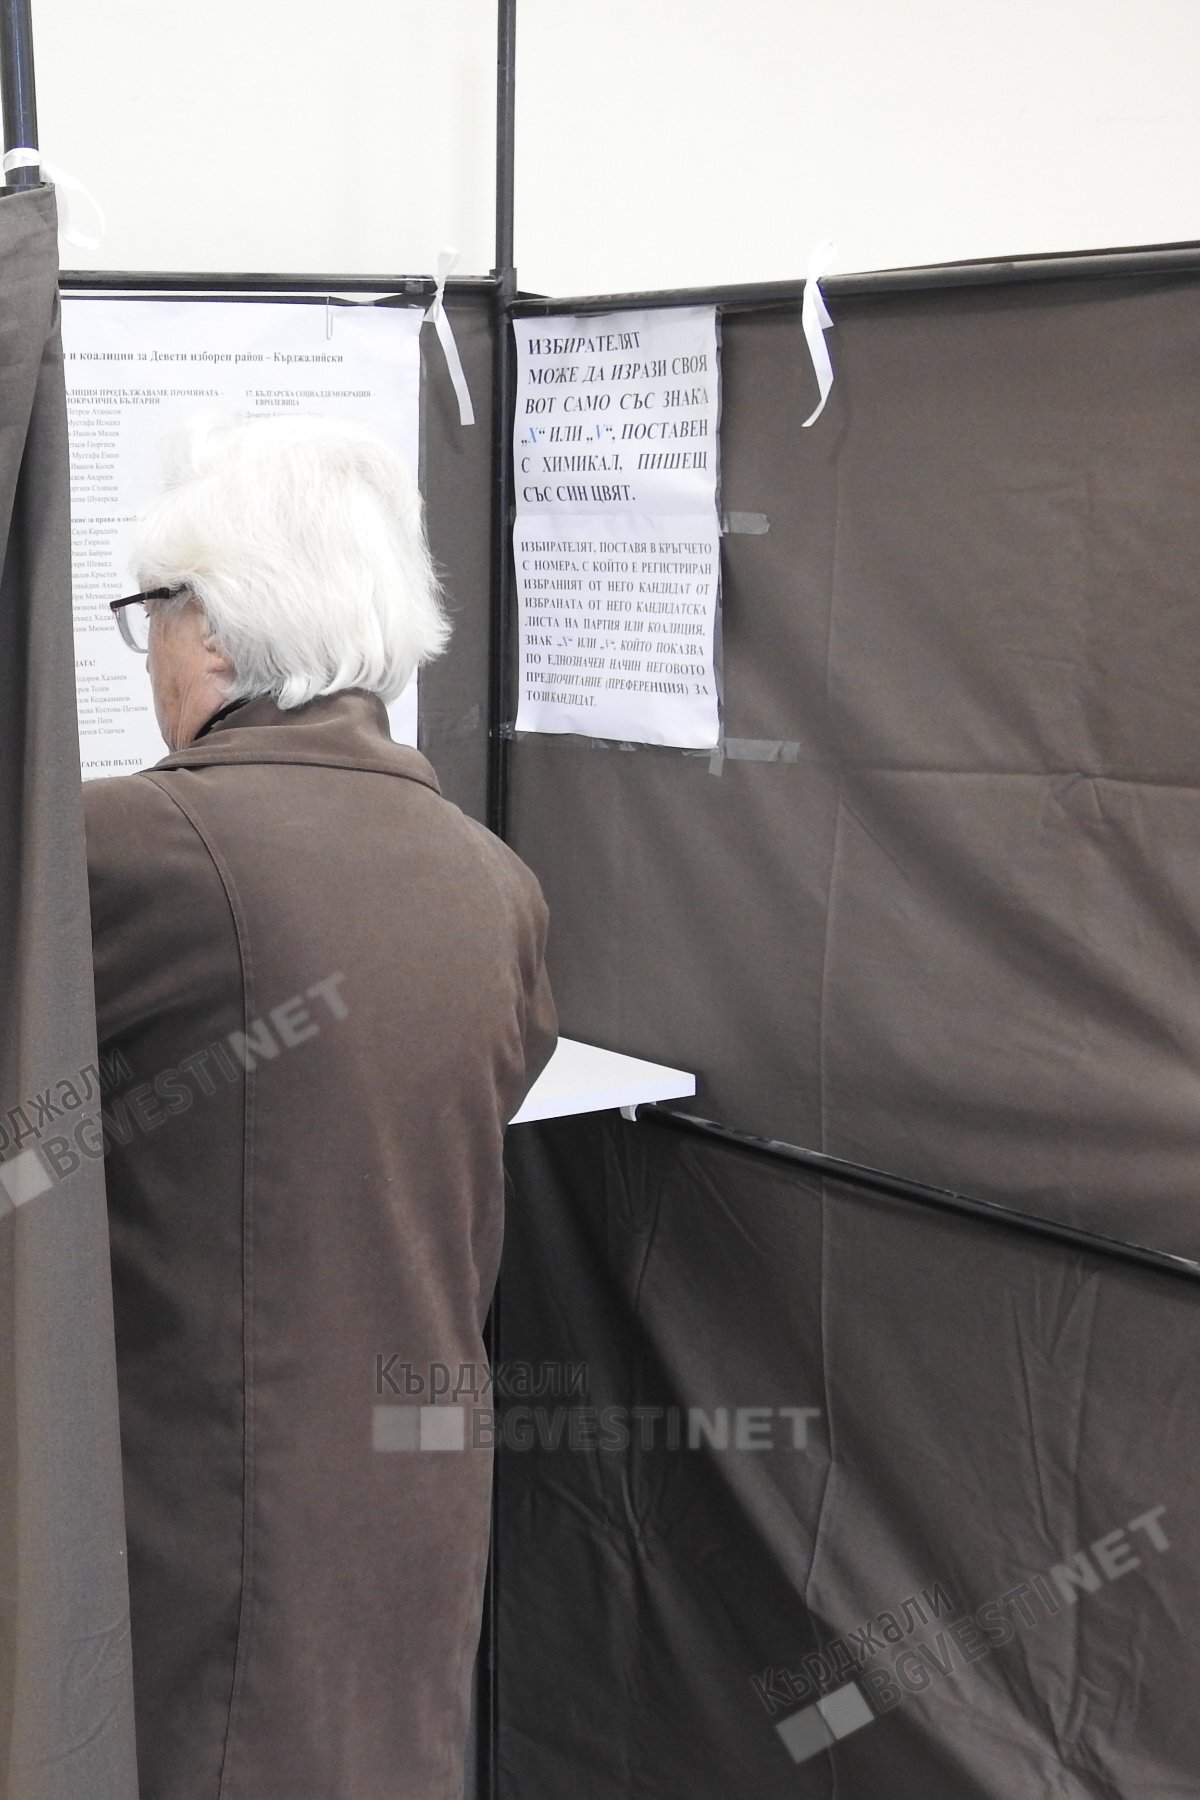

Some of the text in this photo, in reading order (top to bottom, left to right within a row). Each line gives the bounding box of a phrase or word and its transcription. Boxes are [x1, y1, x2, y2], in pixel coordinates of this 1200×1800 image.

[528, 332, 640, 355] ИЗБИРАТЕЛЯТ
[80, 352, 134, 362] коалиции
[137, 352, 148, 361] за
[150, 350, 187, 362] Девети
[190, 351, 232, 364] изборен
[235, 351, 264, 365] район
[274, 352, 344, 365] Кърджалийски
[528, 354, 708, 384] МОЖЕ ДА ИЗРАЗИ СВОЯ
[525, 389, 709, 414] ВОТ САМО СЪС ЗНАКА
[549, 426, 583, 442] ИЛИ
[621, 419, 709, 440] ПОСТАВЕН
[521, 457, 530, 473] С
[637, 451, 707, 471] ПИШЕЩ
[523, 485, 636, 504] СЪС СИН ЦВЯТ.
[599, 542, 647, 553] ПОСТАВЯ
[650, 542, 657, 553] В
[659, 542, 712, 555] КРЪГЧЕТО
[522, 560, 530, 571] С
[582, 561, 589, 572] С
[593, 558, 629, 573] КОЙТО
[632, 562, 638, 573] Е
[641, 562, 712, 575] РЕГИСТРИРАН
[524, 579, 710, 595] ИЗБРАНИЯТ ОТ НЕГО КАНДИДАТ ОТ
[525, 597, 707, 616] ИЗБРАНАТА ОТ НЕГО КАНДИДАТСКА
[524, 616, 560, 628] ЛИСТА
[565, 618, 578, 629] НА
[583, 619, 620, 631] ПАРТИЯ
[624, 620, 644, 632] ИЛИ
[525, 635, 552, 646] ЗНАК
[577, 637, 597, 649] ИЛИ
[620, 638, 651, 653] КОЙТО
[656, 642, 704, 656] ПОКАЗВА
[526, 653, 705, 676] ПО ЕДНОЗНАЧЕН НАЧИН НЕГОВОТО
[526, 672, 709, 696] ПРЕДПОЧИТАНИЕ (ПРЕФЕРЕНЦИЯ) ЗА
